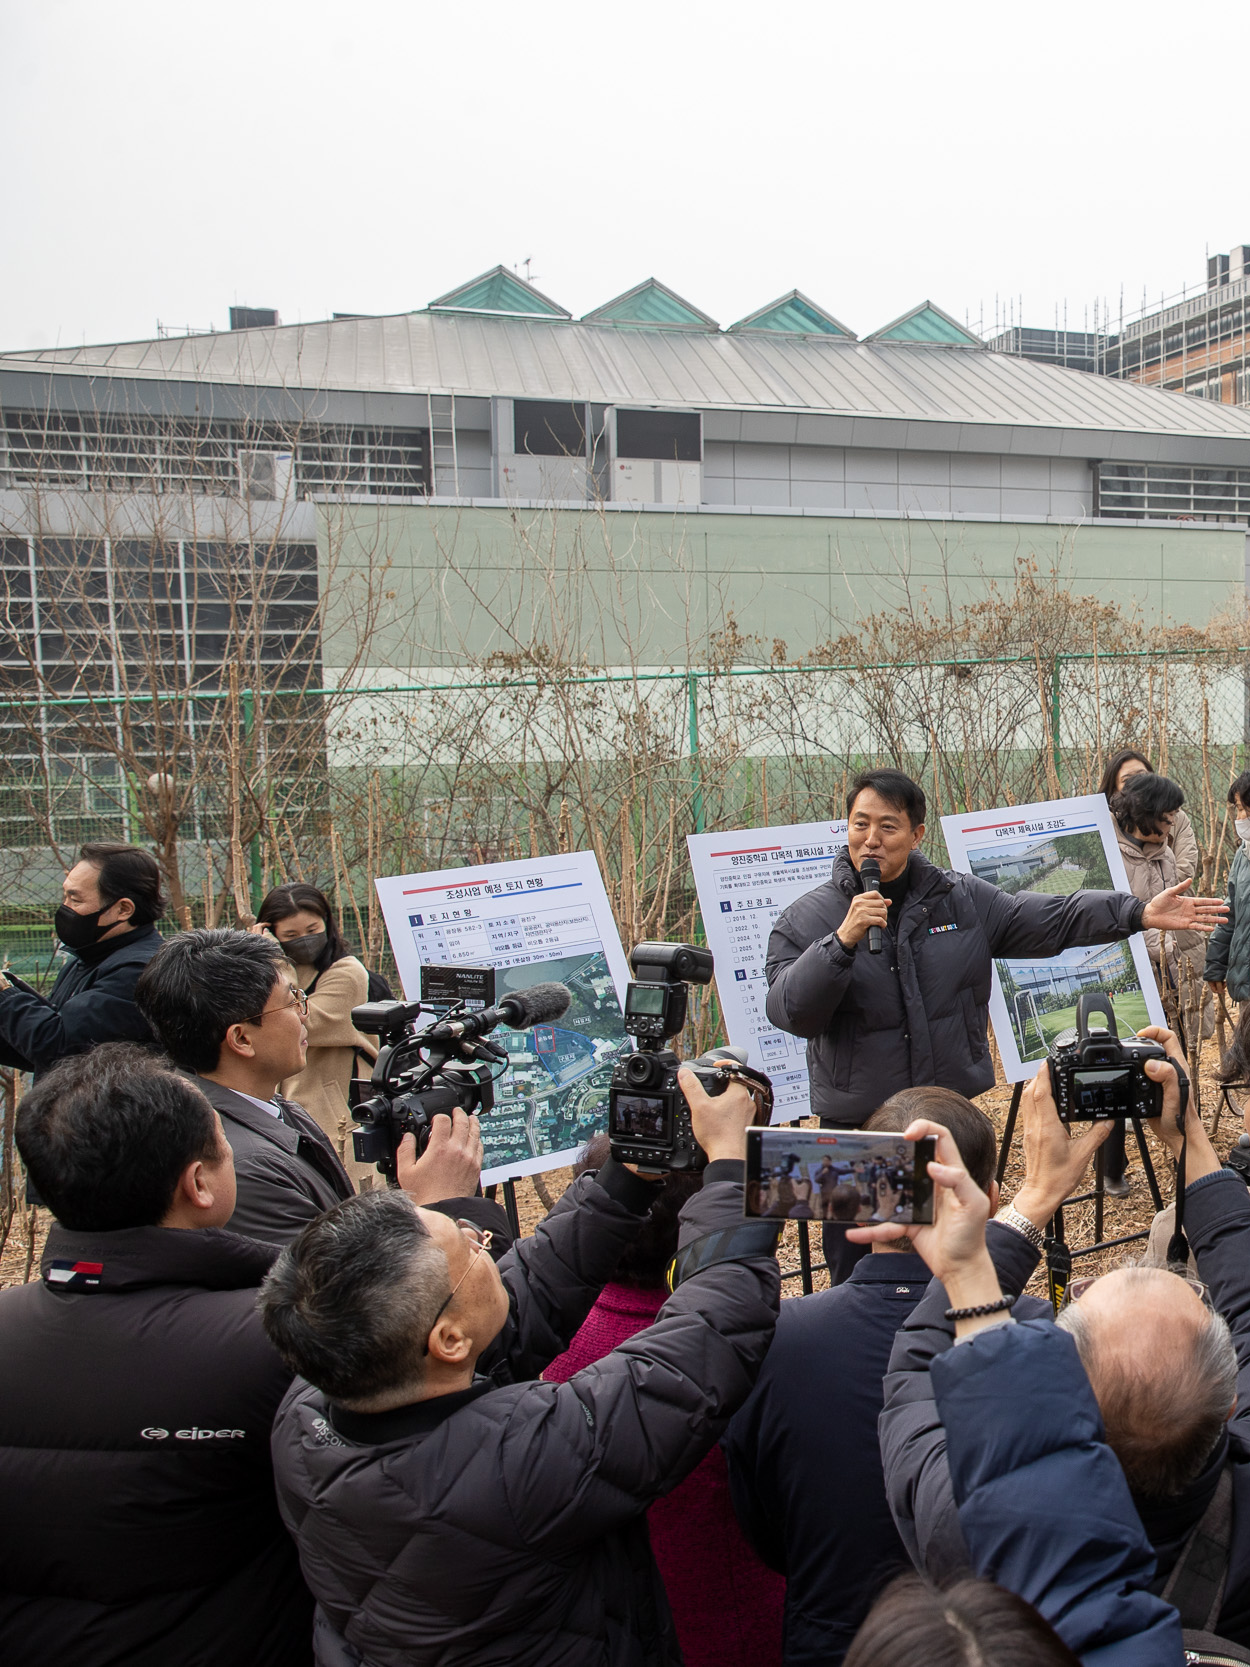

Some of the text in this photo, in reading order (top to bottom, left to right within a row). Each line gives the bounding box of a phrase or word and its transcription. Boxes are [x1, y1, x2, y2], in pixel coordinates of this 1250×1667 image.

[996, 819, 1066, 837] 다목적 체육시설 조감도
[731, 845, 842, 865] 양진중학교 다목적 체육시설 조성
[446, 878, 544, 899] 조성사업 예정 토지 현황
